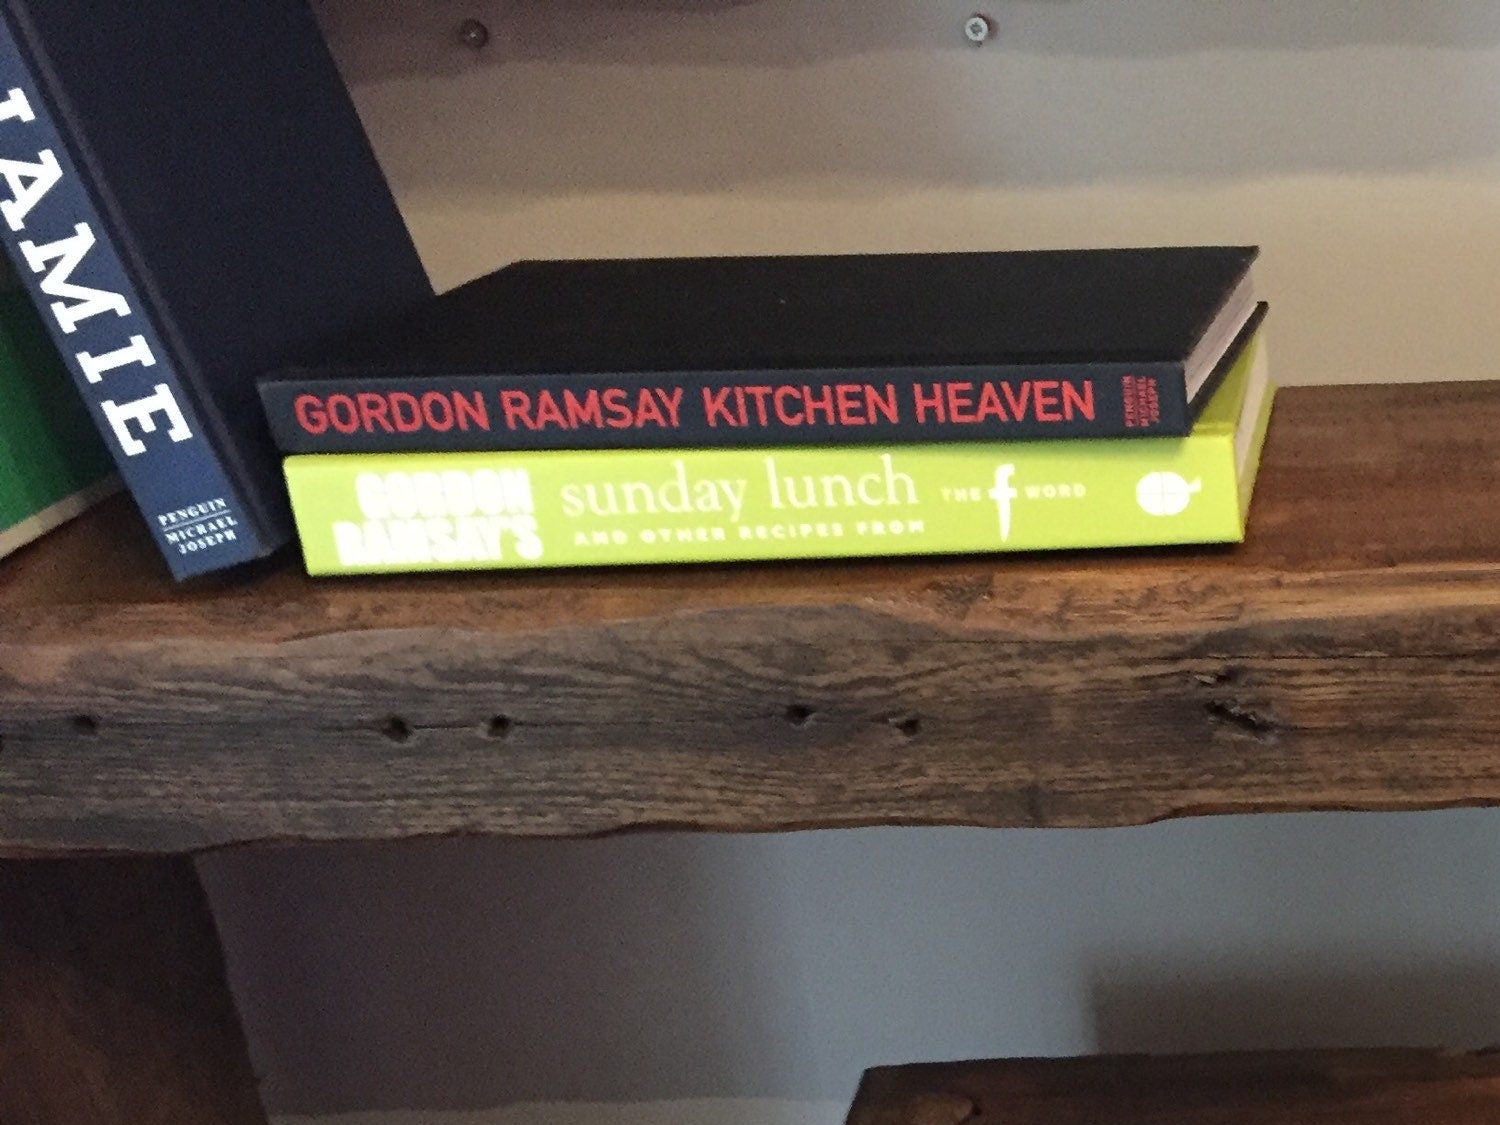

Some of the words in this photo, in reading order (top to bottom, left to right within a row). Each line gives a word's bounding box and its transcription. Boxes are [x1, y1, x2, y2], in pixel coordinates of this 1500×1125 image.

[294, 391, 491, 434] GORDON
[500, 387, 684, 430] RAMSAY
[702, 383, 899, 427] KITCHEN
[912, 380, 1097, 424] HEAVEN
[560, 458, 748, 523] sunday
[764, 452, 919, 510] lunch
[940, 486, 982, 502] THE
[1024, 483, 1086, 499] WORD
[158, 498, 227, 526] PENGUIN
[165, 516, 238, 544] MICHAEL
[179, 529, 237, 554] JOSEPH
[573, 528, 628, 546] AND
[640, 526, 726, 544] OTHER
[738, 522, 844, 541] RECIPES
[856, 519, 925, 537] FROM
